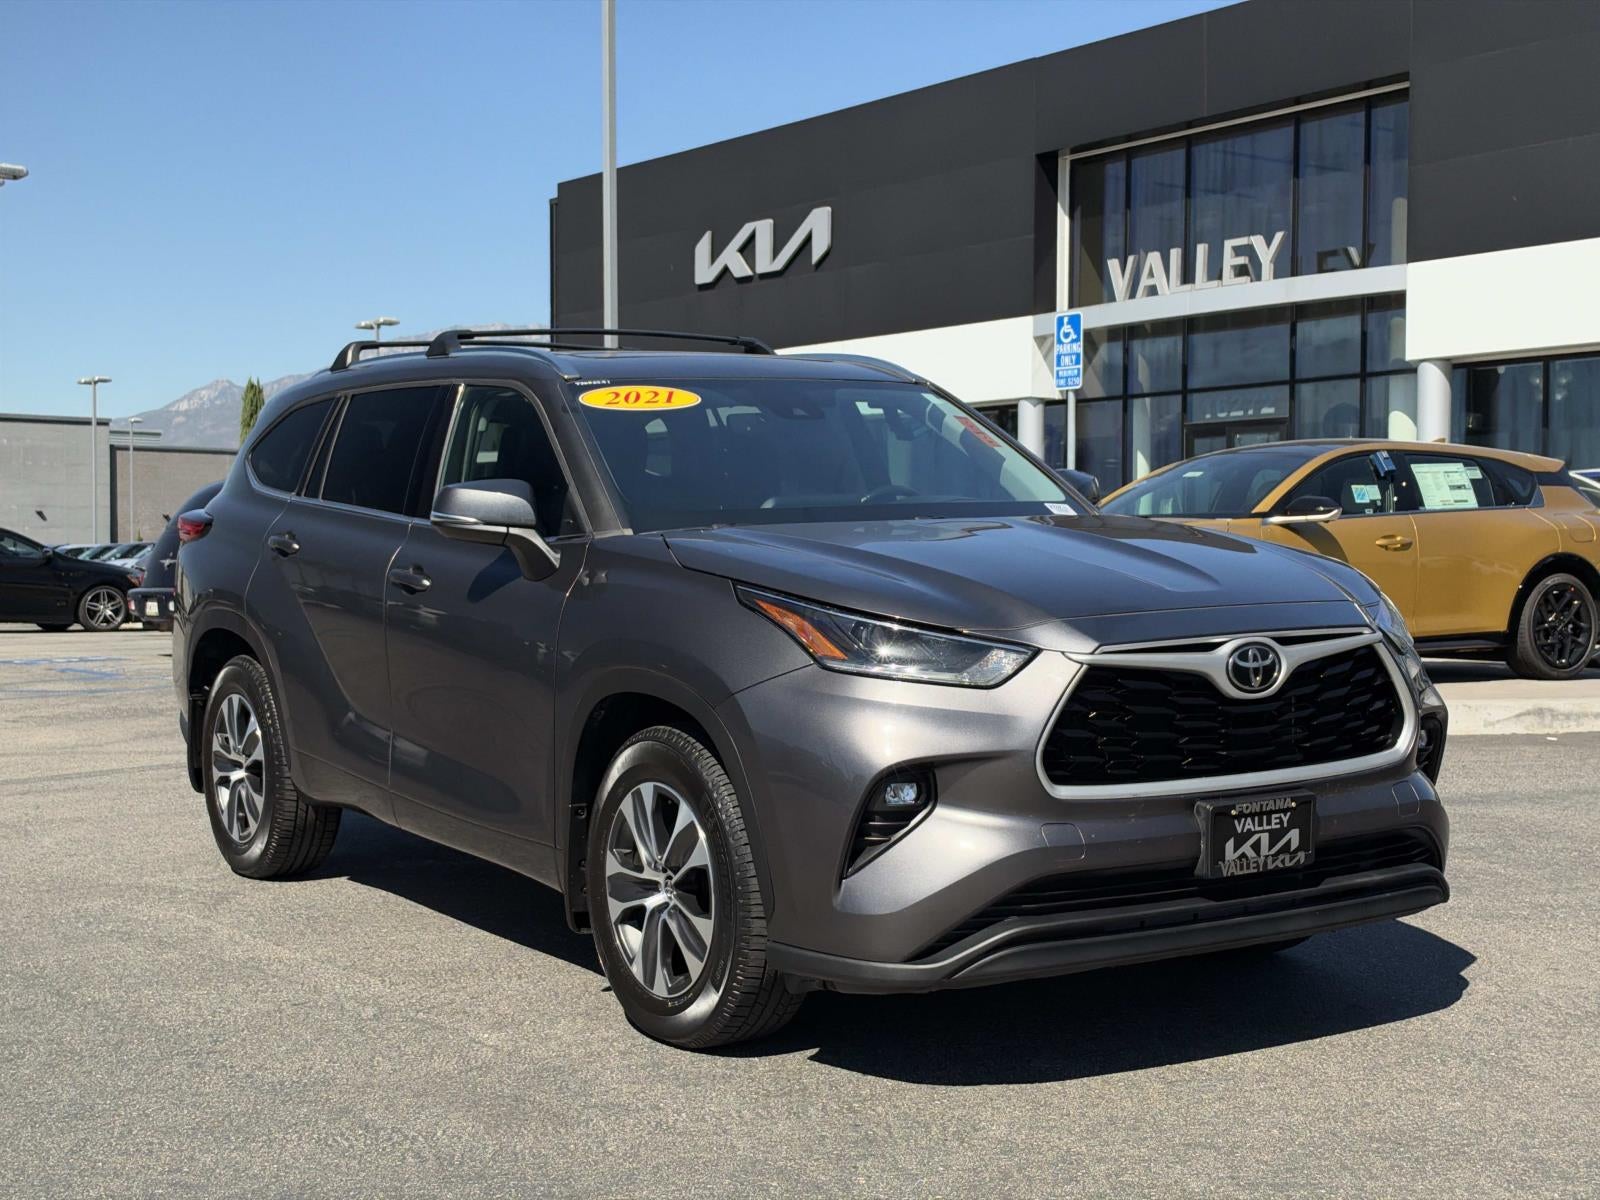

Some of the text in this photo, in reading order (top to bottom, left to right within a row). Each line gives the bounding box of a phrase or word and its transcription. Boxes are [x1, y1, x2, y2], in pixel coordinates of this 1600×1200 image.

[694, 206, 832, 286] KIA
[1107, 231, 1287, 302] VALLEY
[1056, 342, 1081, 354] PARKING
[1060, 354, 1077, 367] ONLY
[606, 390, 676, 405] 2021
[1235, 797, 1293, 815] FONTANA
[1234, 812, 1292, 834] VALLEY
[1218, 856, 1266, 878] VALLEY
